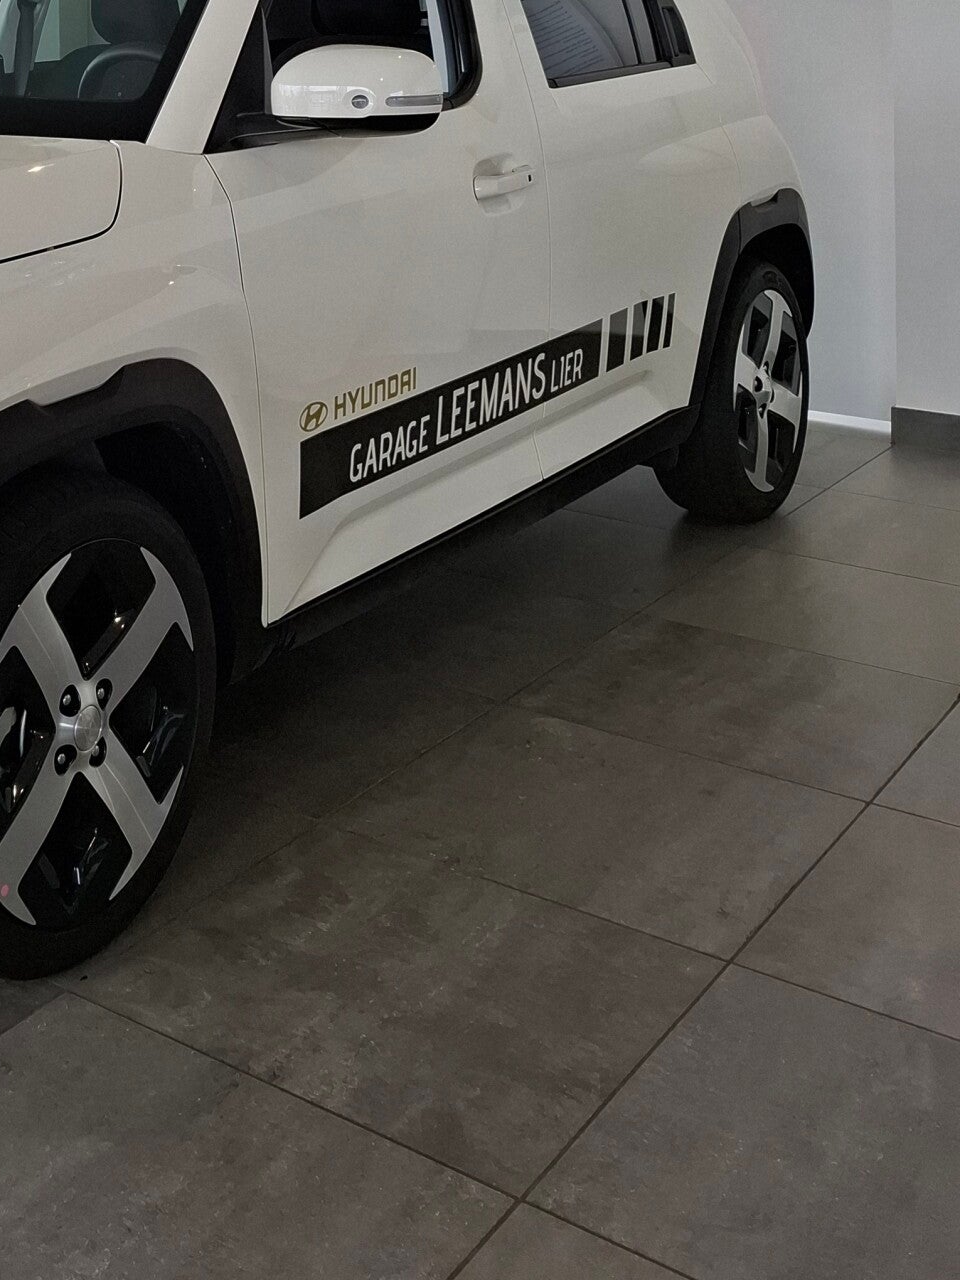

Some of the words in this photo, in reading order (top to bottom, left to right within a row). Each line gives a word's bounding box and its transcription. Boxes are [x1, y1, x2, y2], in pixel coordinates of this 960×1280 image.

[333, 366, 418, 420] HYUNDAI
[349, 414, 430, 483] GARAGE
[435, 352, 546, 445] LEEMANS
[550, 348, 584, 394] LIER
